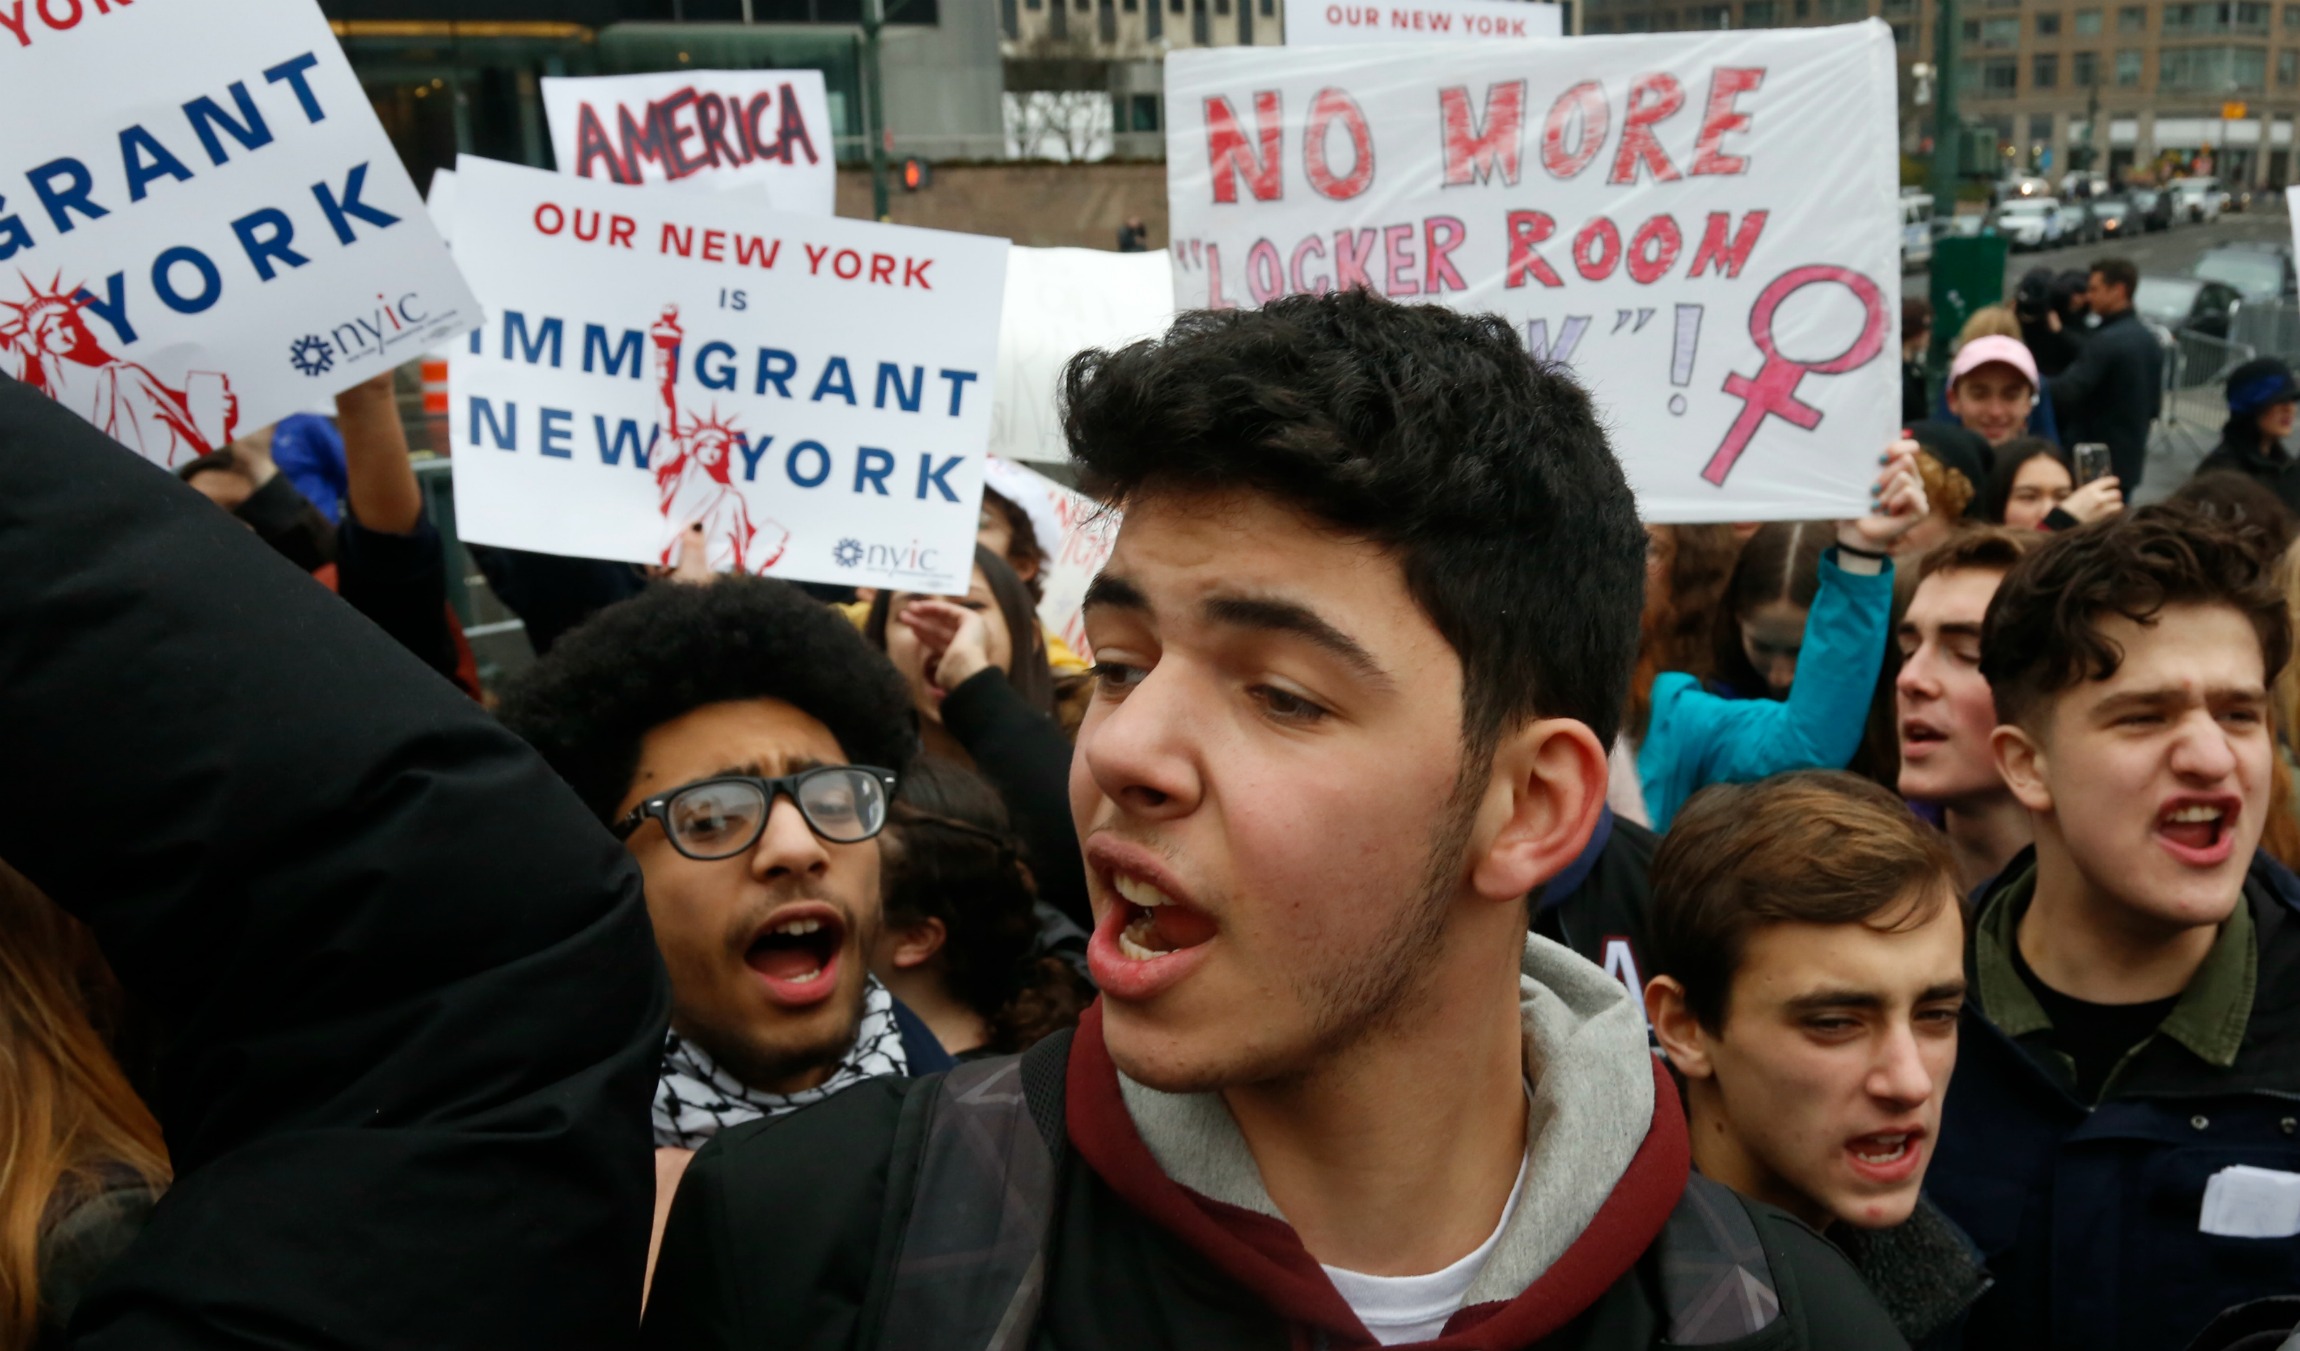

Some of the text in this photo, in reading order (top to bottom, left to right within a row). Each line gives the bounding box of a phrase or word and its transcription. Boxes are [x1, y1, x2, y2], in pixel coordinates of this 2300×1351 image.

[0, 0, 134, 47] YO
[1326, 4, 1527, 37] OUR NEW YORK
[576, 82, 818, 186] AMERICA
[1203, 66, 1767, 205] NO MORE
[73, 161, 403, 346] YORK
[533, 202, 934, 290] OUR NEW YORK
[1504, 209, 1770, 290] ROOM
[331, 291, 429, 356] nyic
[718, 288, 748, 312] IS
[469, 396, 966, 503] NEW YORK
[867, 539, 939, 578] nyic
